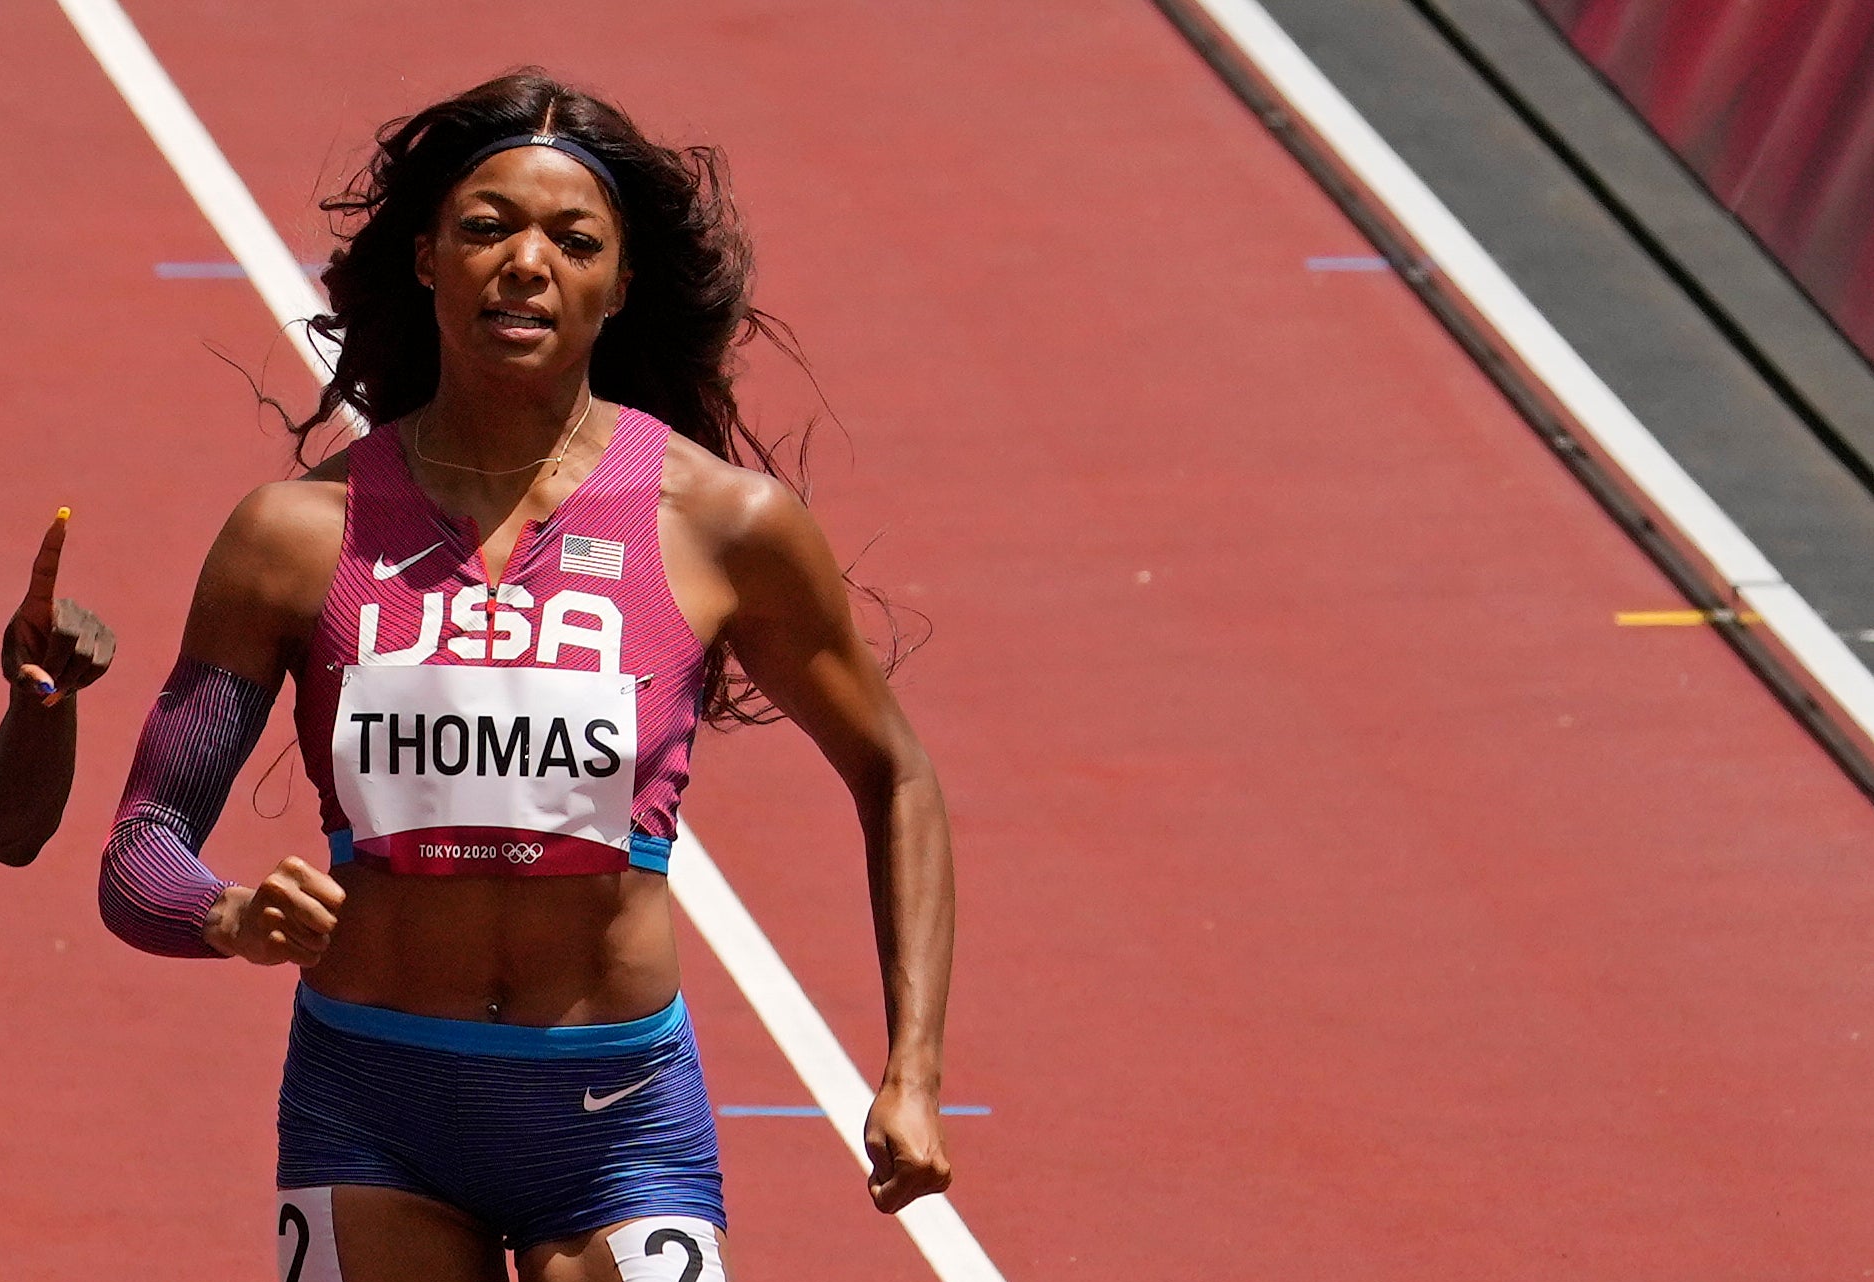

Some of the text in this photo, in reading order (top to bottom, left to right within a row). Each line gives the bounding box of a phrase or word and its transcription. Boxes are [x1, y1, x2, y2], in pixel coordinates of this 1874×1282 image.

[357, 582, 624, 674] USA
[350, 712, 621, 778] THOMAS
[419, 844, 497, 859] TOKYO 2020
